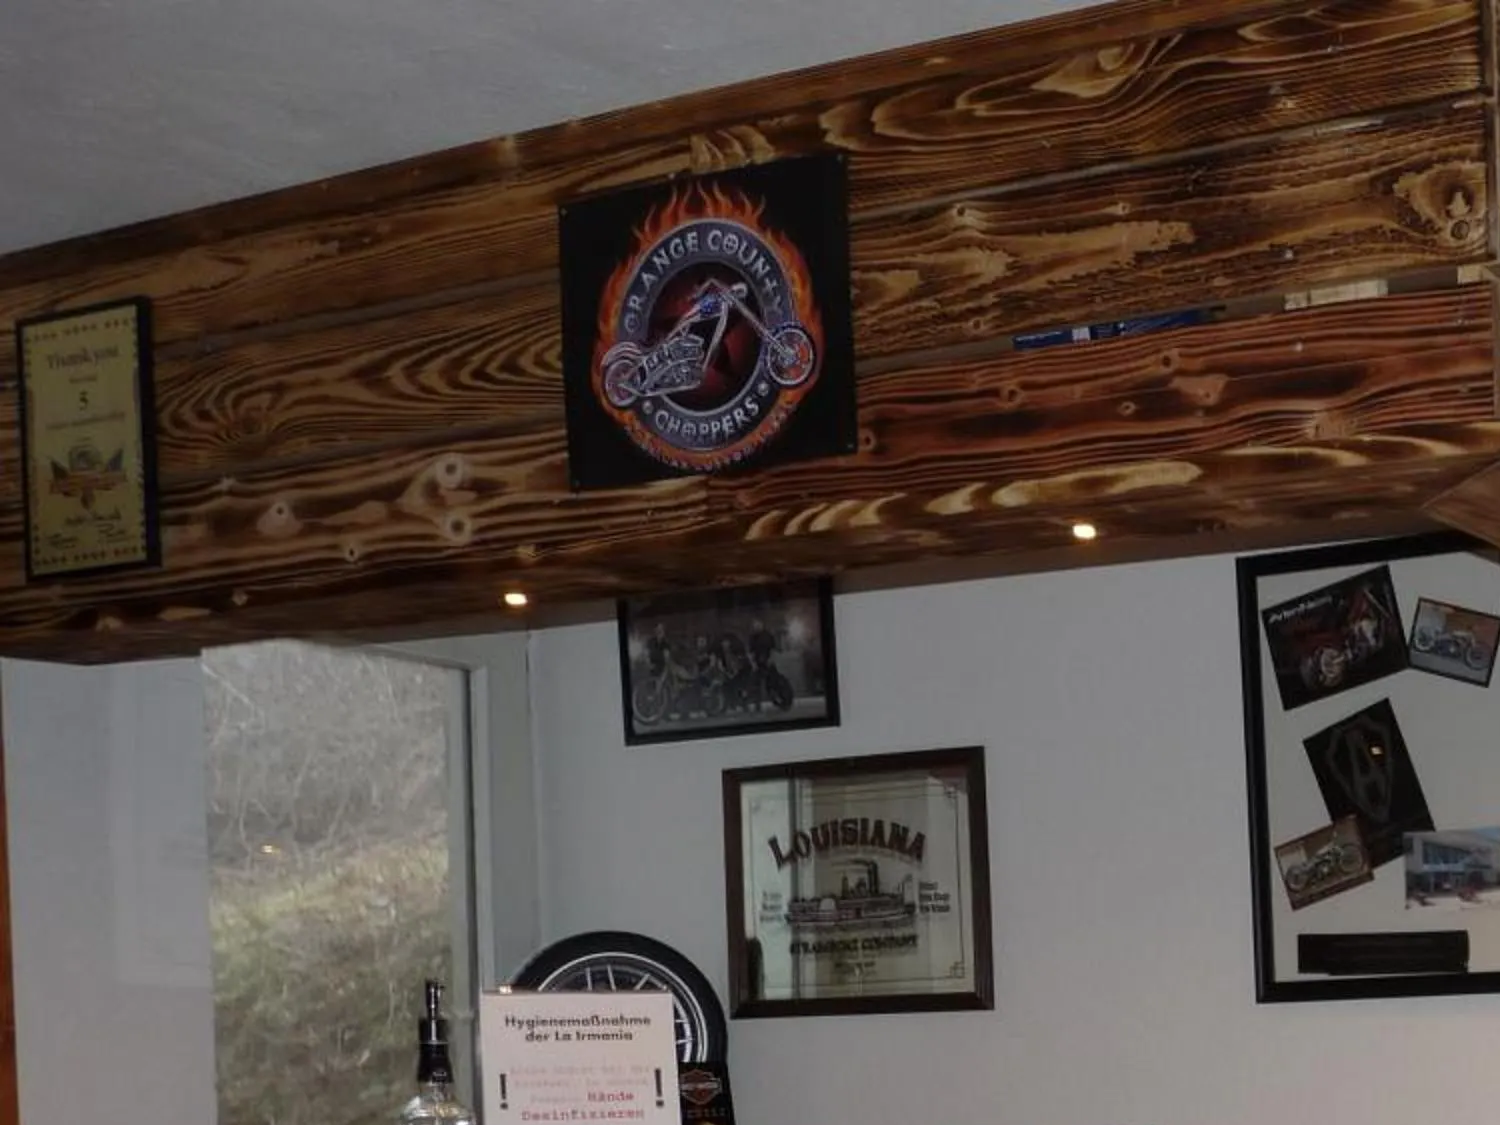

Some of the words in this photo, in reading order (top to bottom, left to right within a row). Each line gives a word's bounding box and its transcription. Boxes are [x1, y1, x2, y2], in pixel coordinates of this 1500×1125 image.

[624, 230, 699, 334] ORANGE
[706, 228, 786, 323] COUNTY
[654, 399, 760, 438] CHOPPERS
[768, 817, 926, 872] LOUISIANA
[525, 1031, 550, 1042] der
[554, 1031, 572, 1042] La
